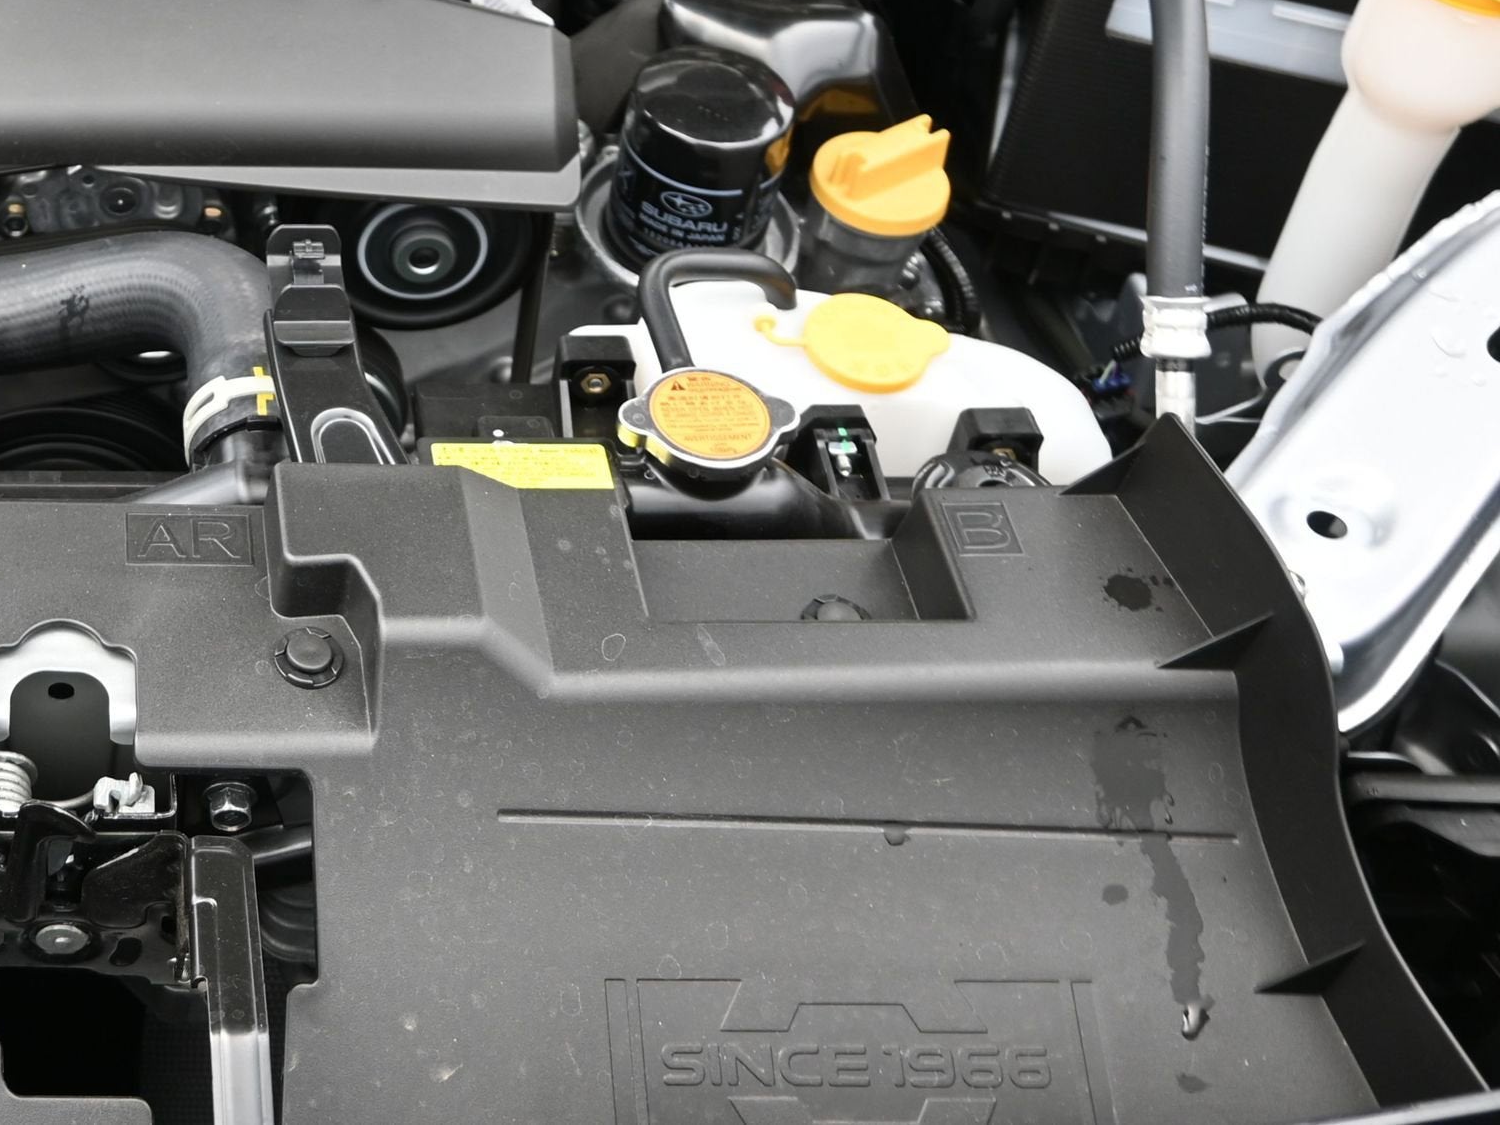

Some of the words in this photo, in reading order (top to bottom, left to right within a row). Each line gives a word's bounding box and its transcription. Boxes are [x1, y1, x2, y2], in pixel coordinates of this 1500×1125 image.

[638, 211, 669, 234] MADE
[670, 228, 685, 238] IN
[686, 233, 726, 242] JAPAN
[640, 201, 729, 234] SUBARU
[137, 517, 242, 558] AR
[955, 508, 1012, 550] B
[660, 1042, 872, 1089] SINCE
[882, 1042, 1053, 1090] 1966
